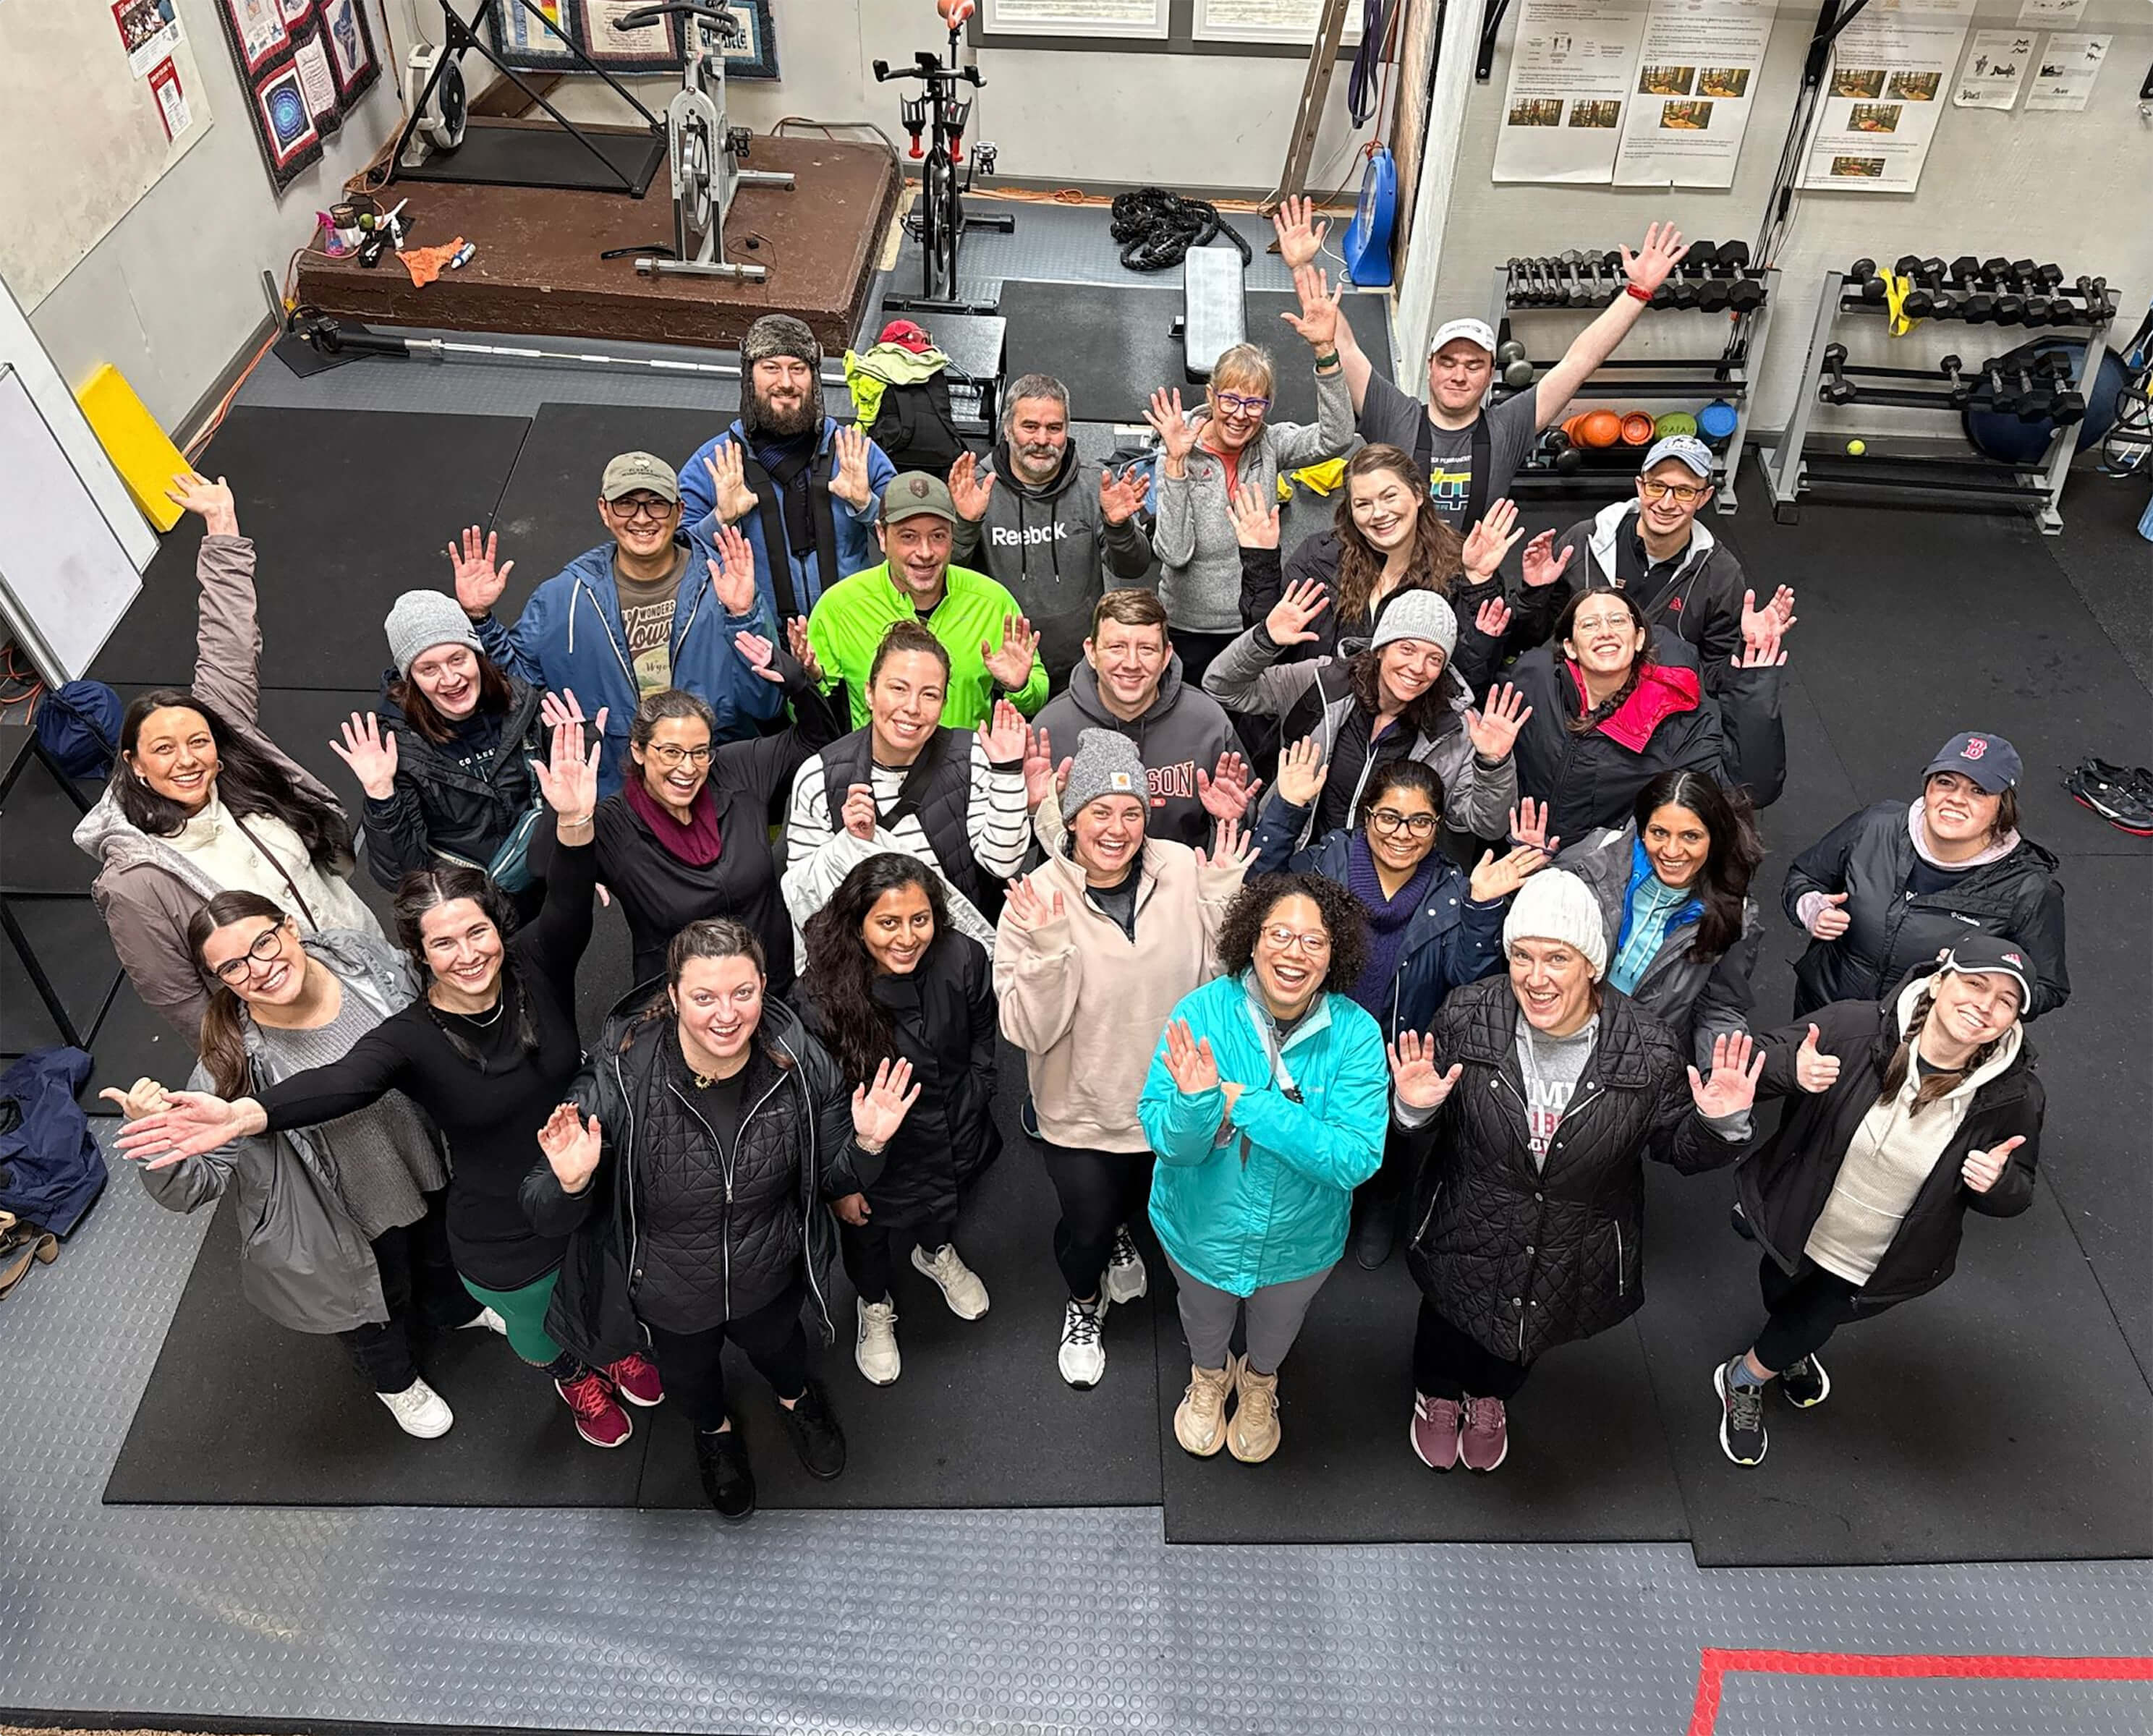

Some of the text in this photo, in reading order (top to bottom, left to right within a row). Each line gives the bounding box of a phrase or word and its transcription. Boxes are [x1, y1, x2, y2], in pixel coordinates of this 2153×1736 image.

[991, 520, 1069, 546] Reebok
[639, 600, 676, 620] WONDERS
[1959, 736, 1988, 761] B
